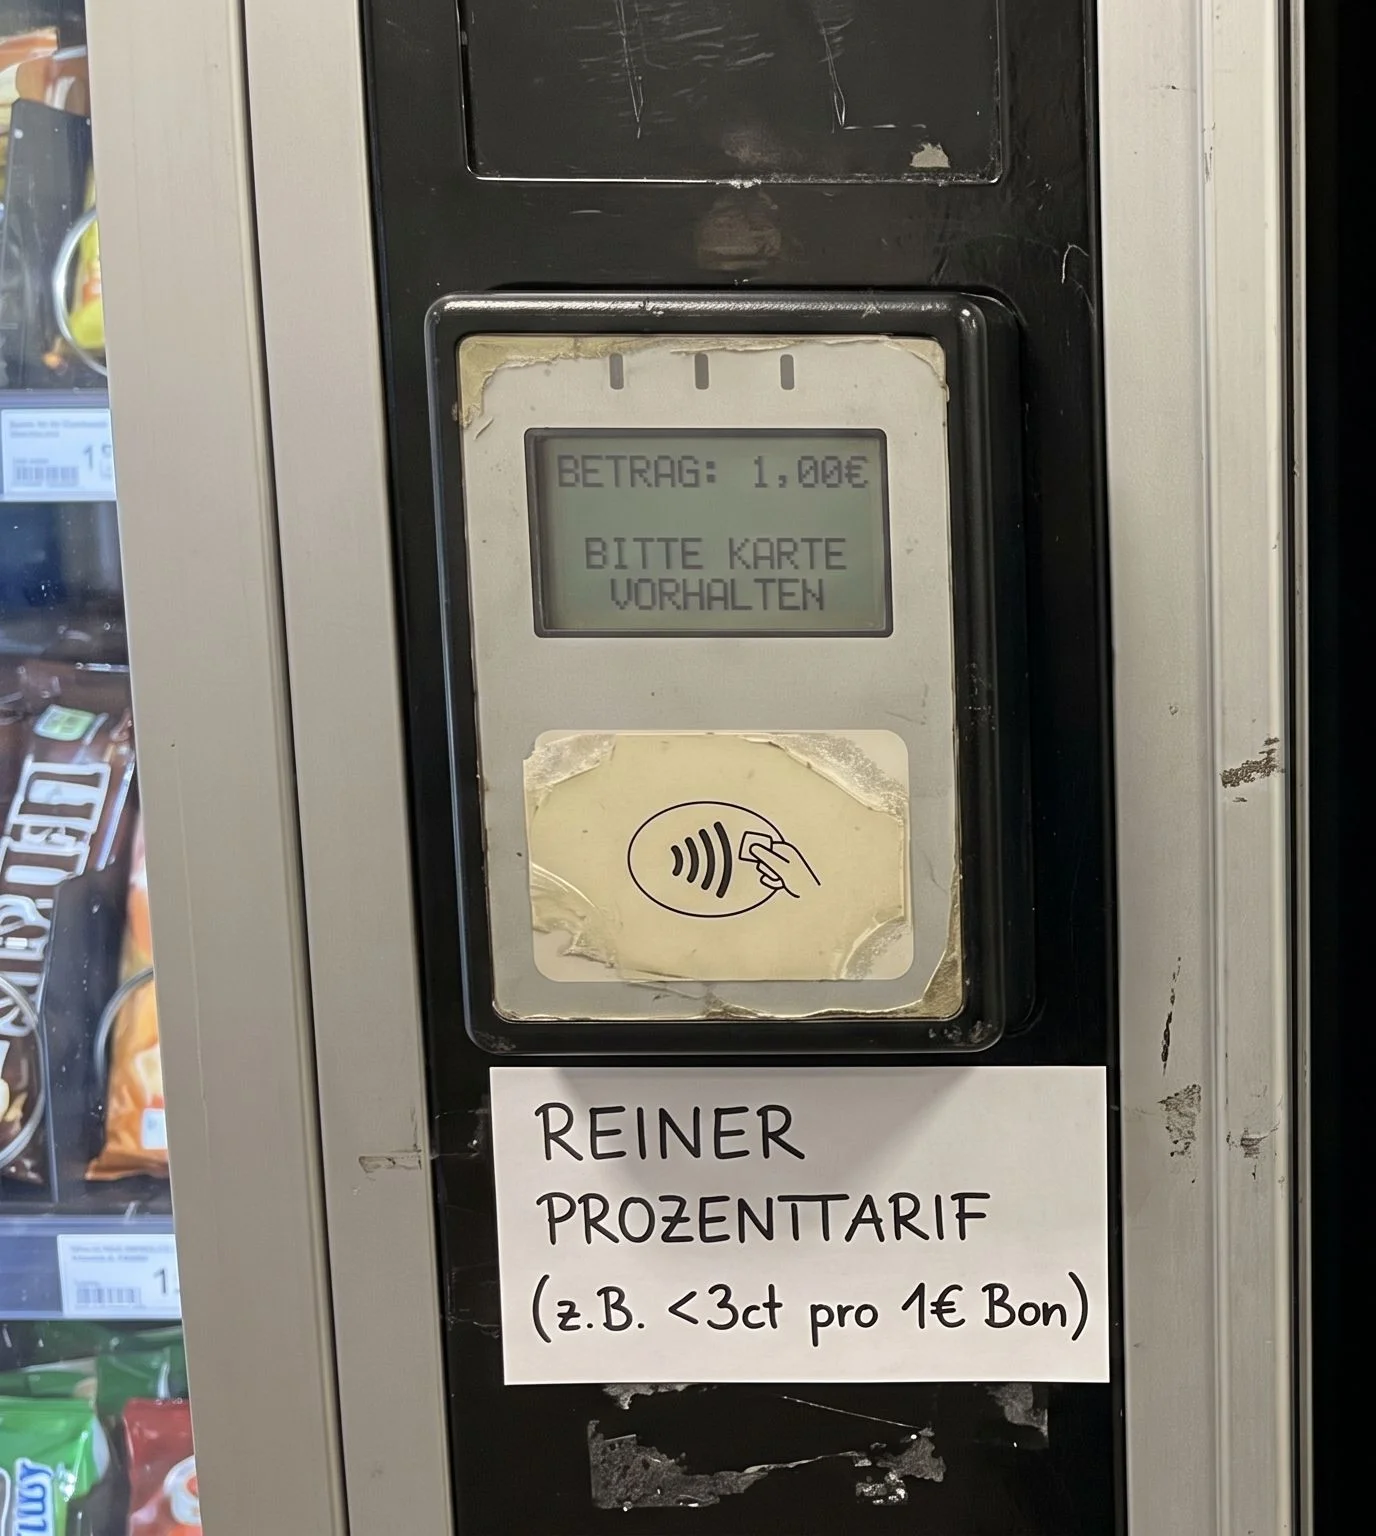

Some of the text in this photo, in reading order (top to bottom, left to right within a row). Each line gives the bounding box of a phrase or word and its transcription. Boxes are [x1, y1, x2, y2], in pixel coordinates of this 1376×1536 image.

[556, 455, 869, 489] BETRAG: 1,00€
[584, 537, 847, 570] BITTE KARTE
[610, 578, 825, 611] VORHALTEN
[534, 1102, 806, 1162] REINER
[535, 1191, 991, 1246] PROZENTTARIF
[531, 1271, 1089, 1348] (z.B. <3ct pro 1€ Bon)
